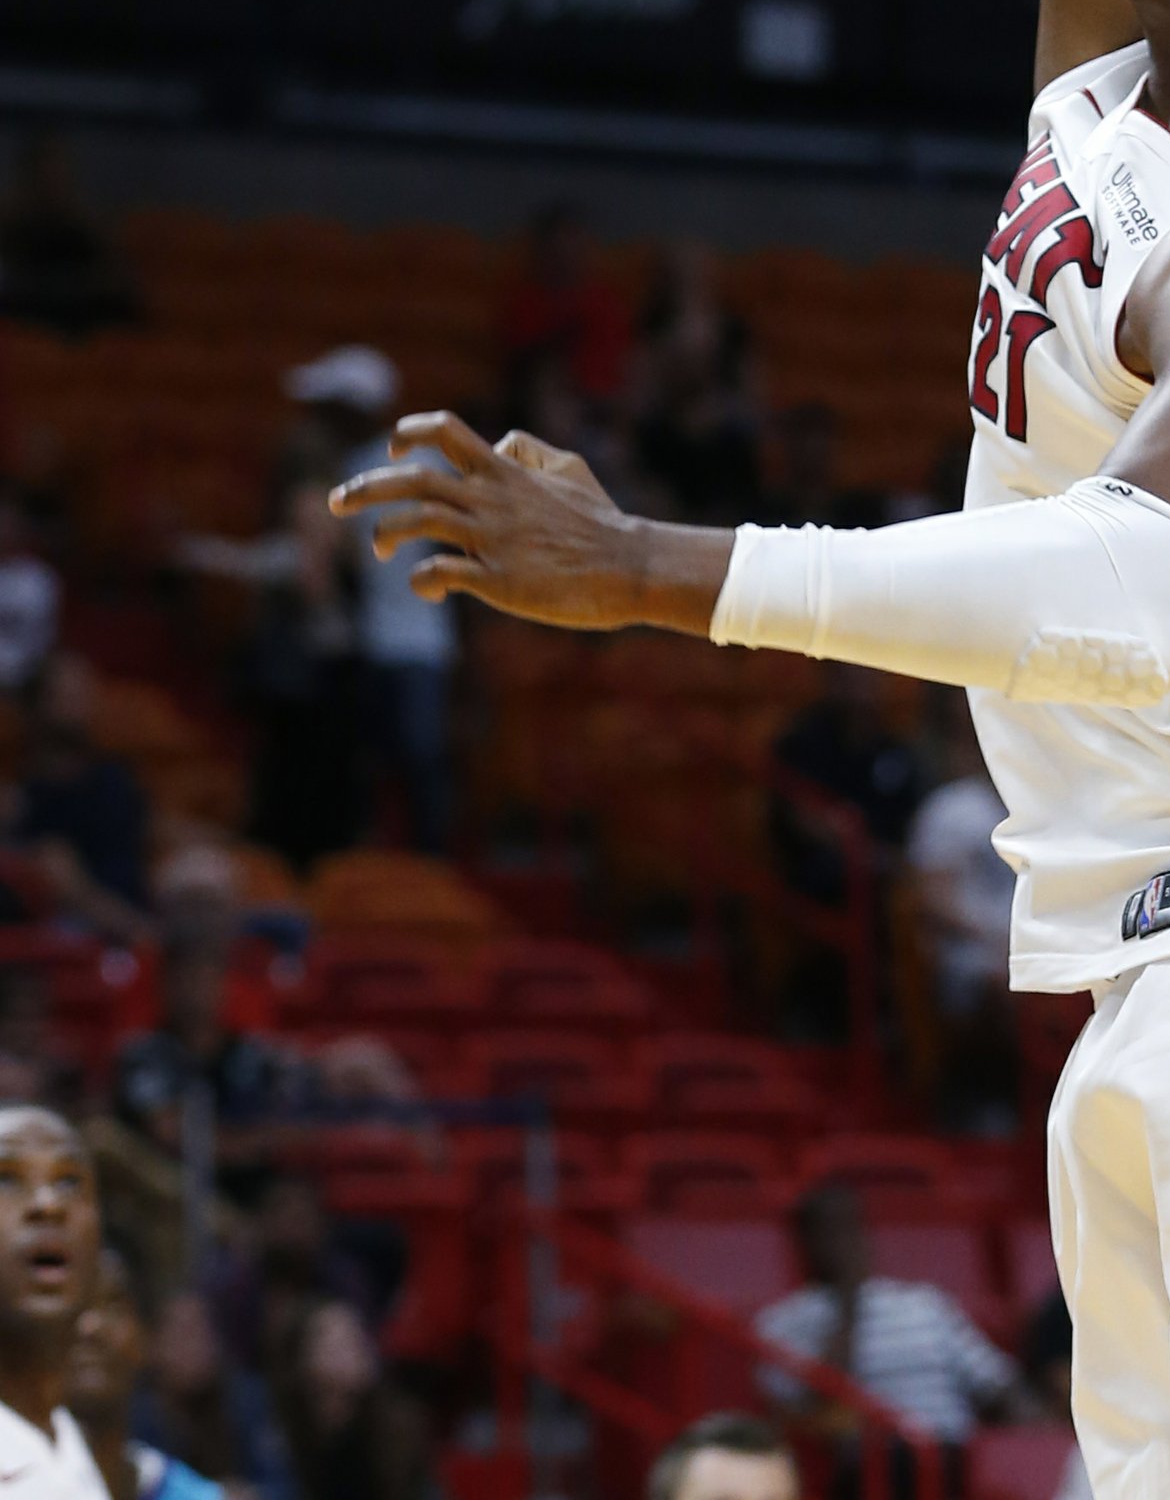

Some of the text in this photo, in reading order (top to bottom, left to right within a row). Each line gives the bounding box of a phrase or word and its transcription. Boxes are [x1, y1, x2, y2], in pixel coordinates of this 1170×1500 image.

[1101, 185, 1141, 246] SOFTWARE
[1111, 162, 1159, 242] Ultimate
[971, 284, 1057, 444] 21
